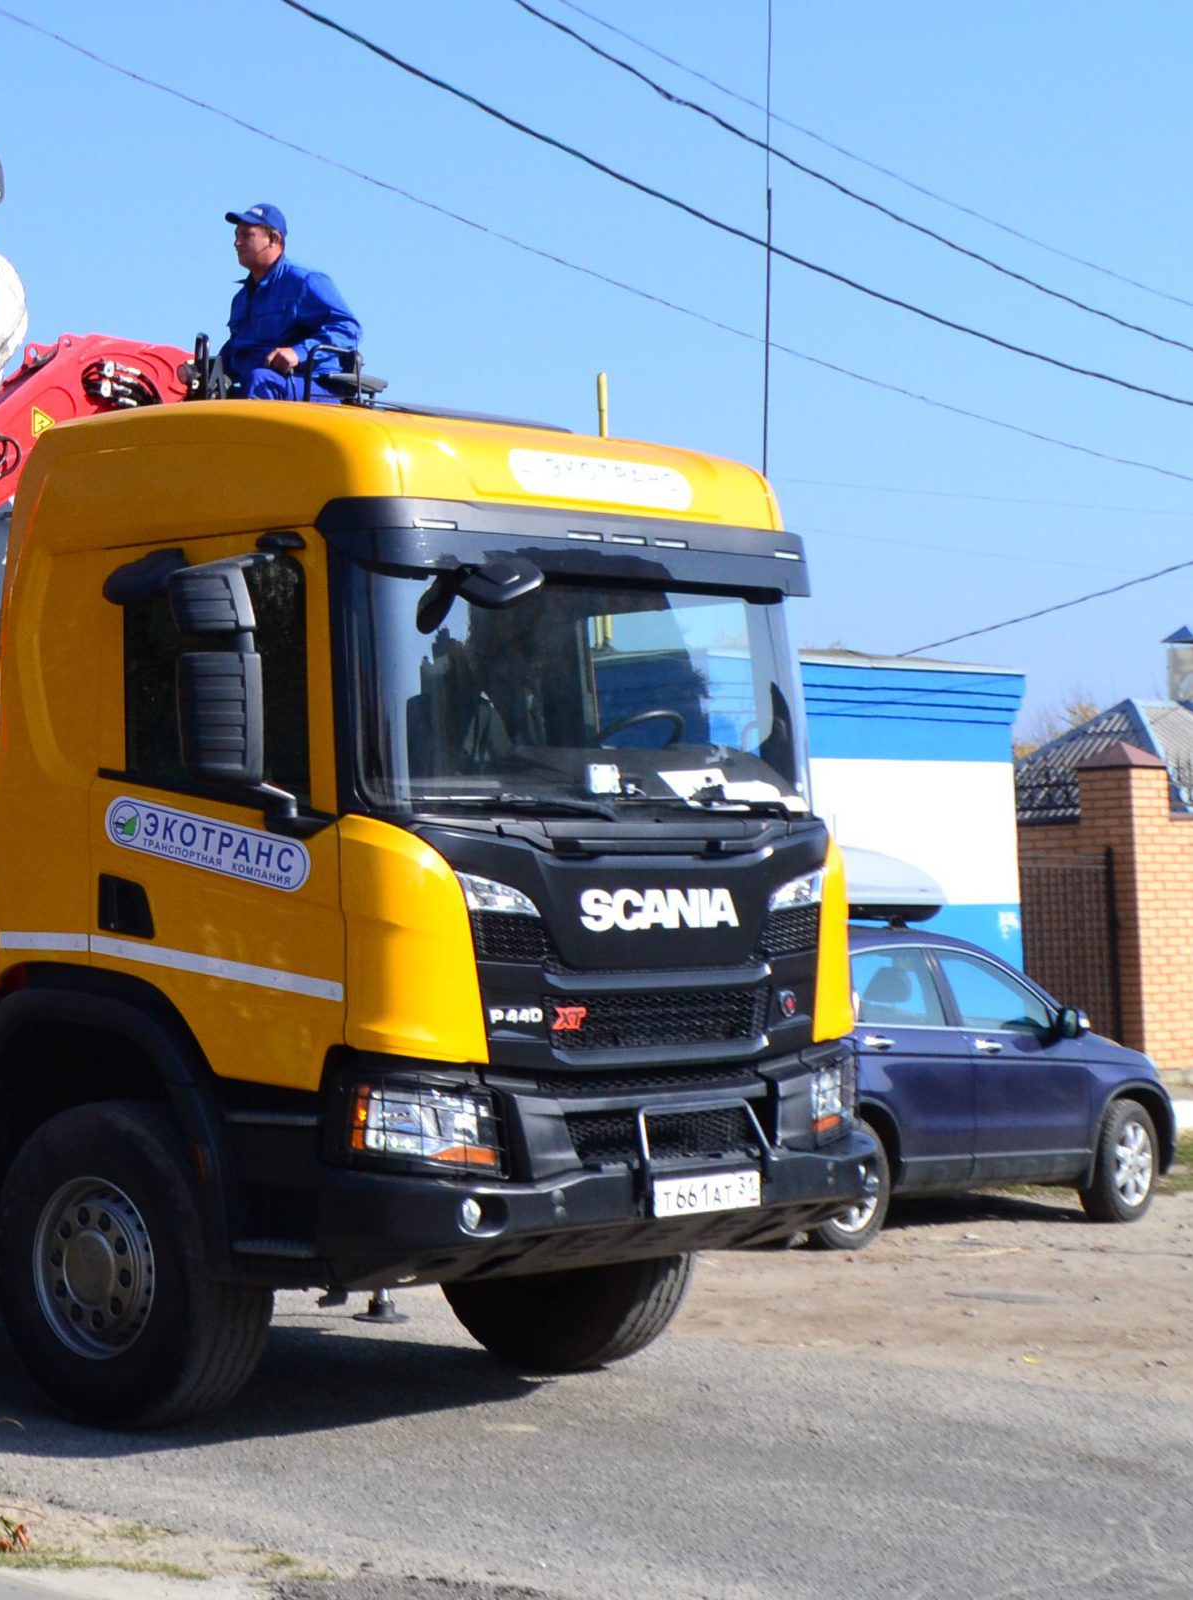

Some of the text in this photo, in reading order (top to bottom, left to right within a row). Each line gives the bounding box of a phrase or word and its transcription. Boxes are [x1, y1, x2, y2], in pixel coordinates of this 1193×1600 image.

[142, 838, 291, 886] ТРАНСПОРТНАЯ КОМПАНИЯ
[144, 812, 295, 873] ЭКОТРАНС
[580, 888, 740, 932] SCANIA
[552, 1006, 587, 1031] XT
